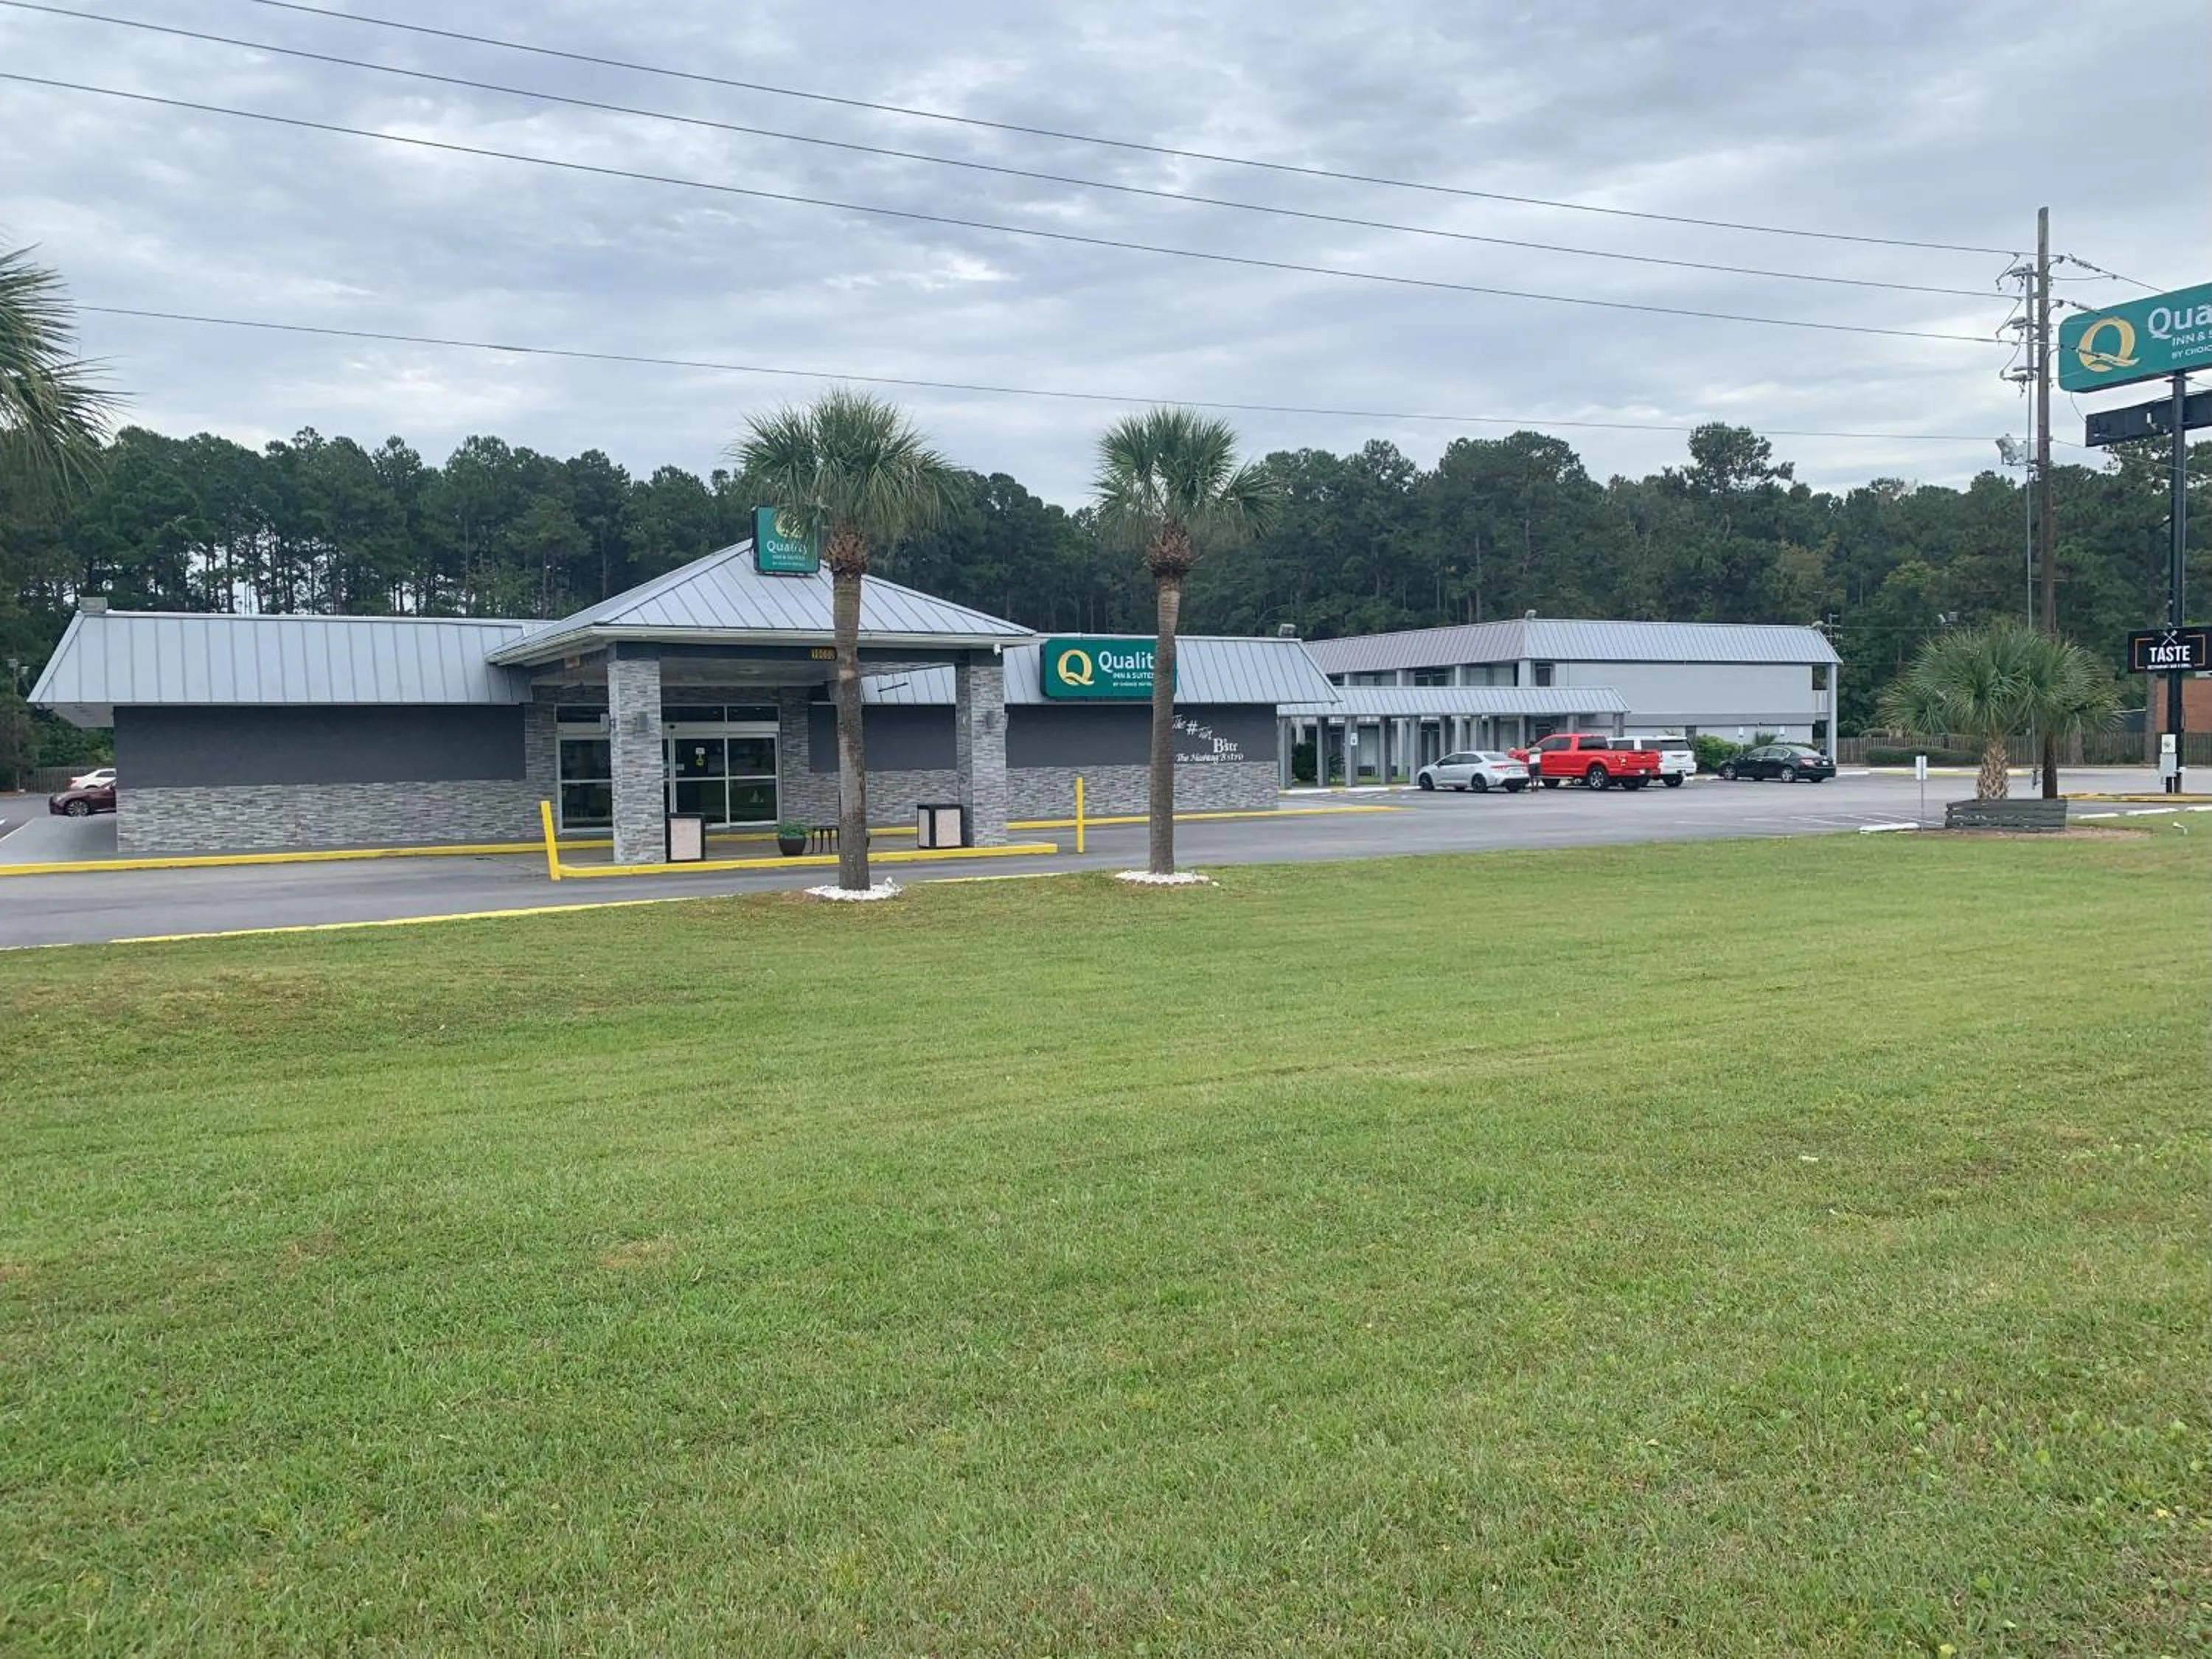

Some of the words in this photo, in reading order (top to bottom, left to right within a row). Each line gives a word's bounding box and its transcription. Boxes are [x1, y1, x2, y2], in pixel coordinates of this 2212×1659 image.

[2148, 304, 2212, 339] Qua
[2171, 333, 2195, 347] INN
[2197, 331, 2206, 341] &
[2185, 344, 2212, 356] CHOIC
[1098, 650, 1155, 673] Qualit
[2149, 645, 2191, 663] TASTE
[1057, 649, 1095, 686] Q
